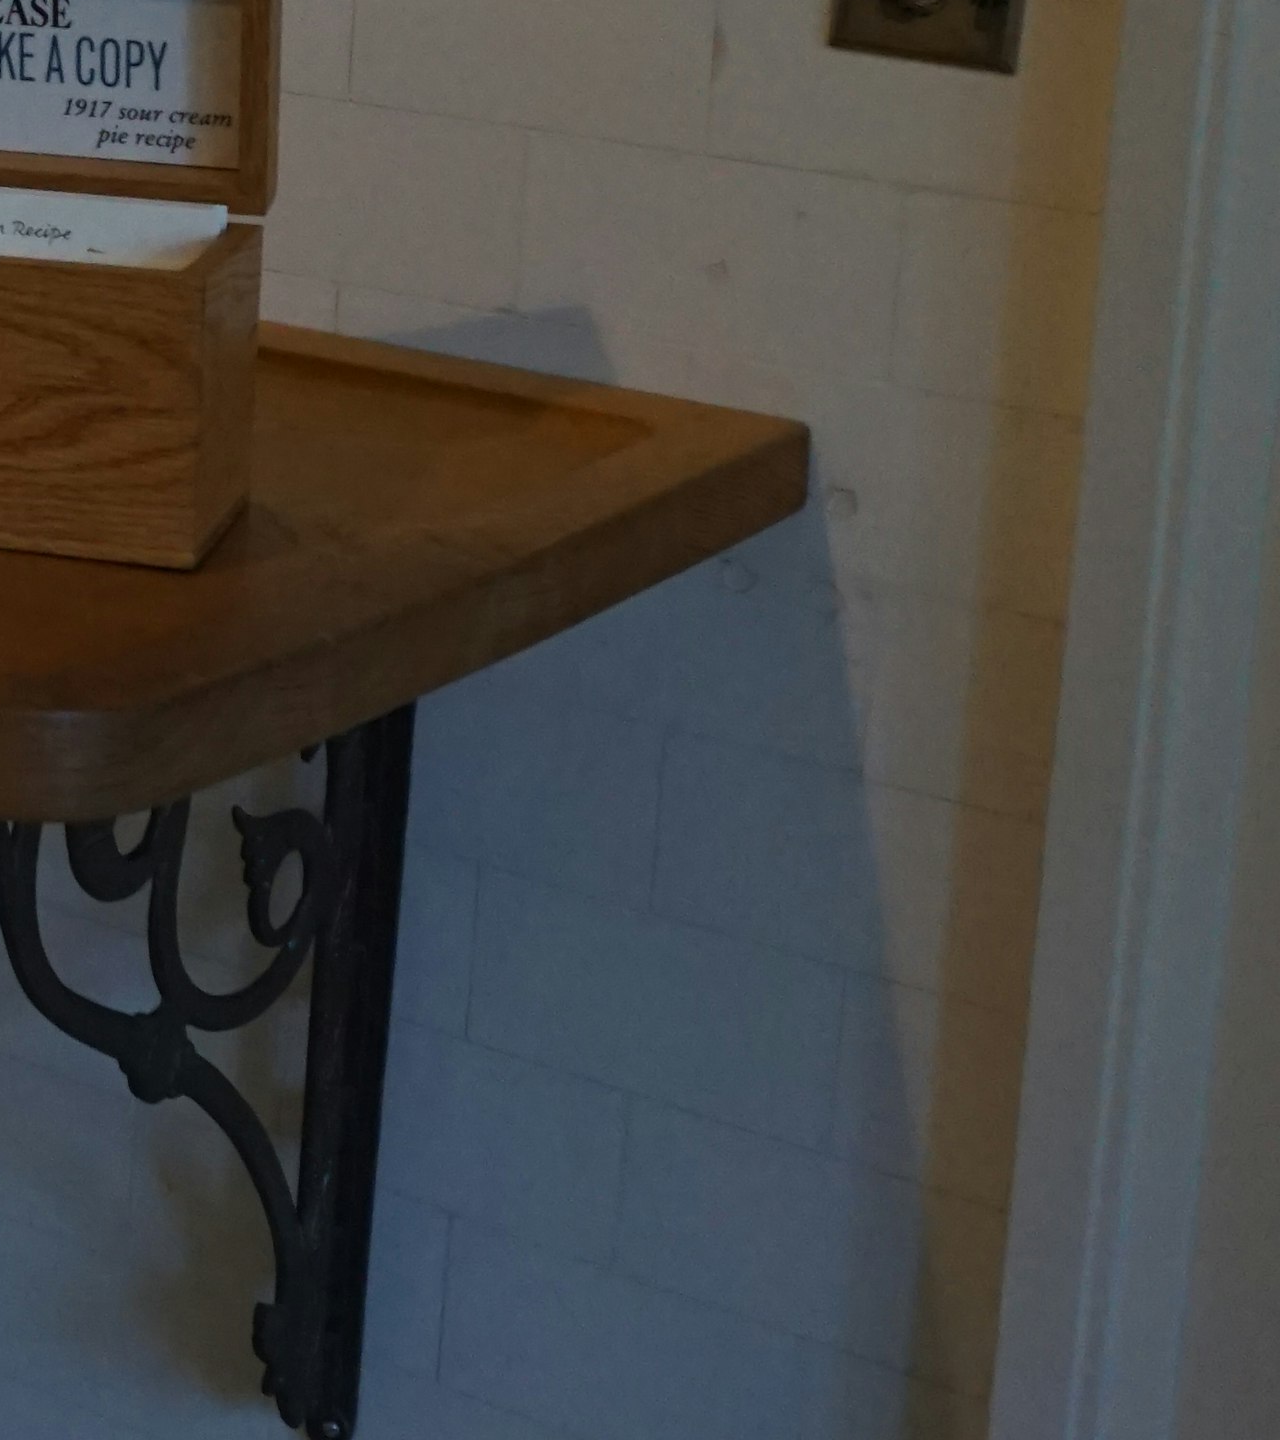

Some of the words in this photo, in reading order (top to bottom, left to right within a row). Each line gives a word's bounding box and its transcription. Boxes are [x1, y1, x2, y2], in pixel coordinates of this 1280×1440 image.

[45, 34, 65, 84] A
[75, 36, 168, 91] COPY
[63, 97, 113, 118] 1917
[118, 106, 164, 122] sour
[168, 109, 233, 128] cream
[96, 124, 130, 149] pie
[134, 128, 197, 154] recipe
[11, 220, 73, 246] Recipe
